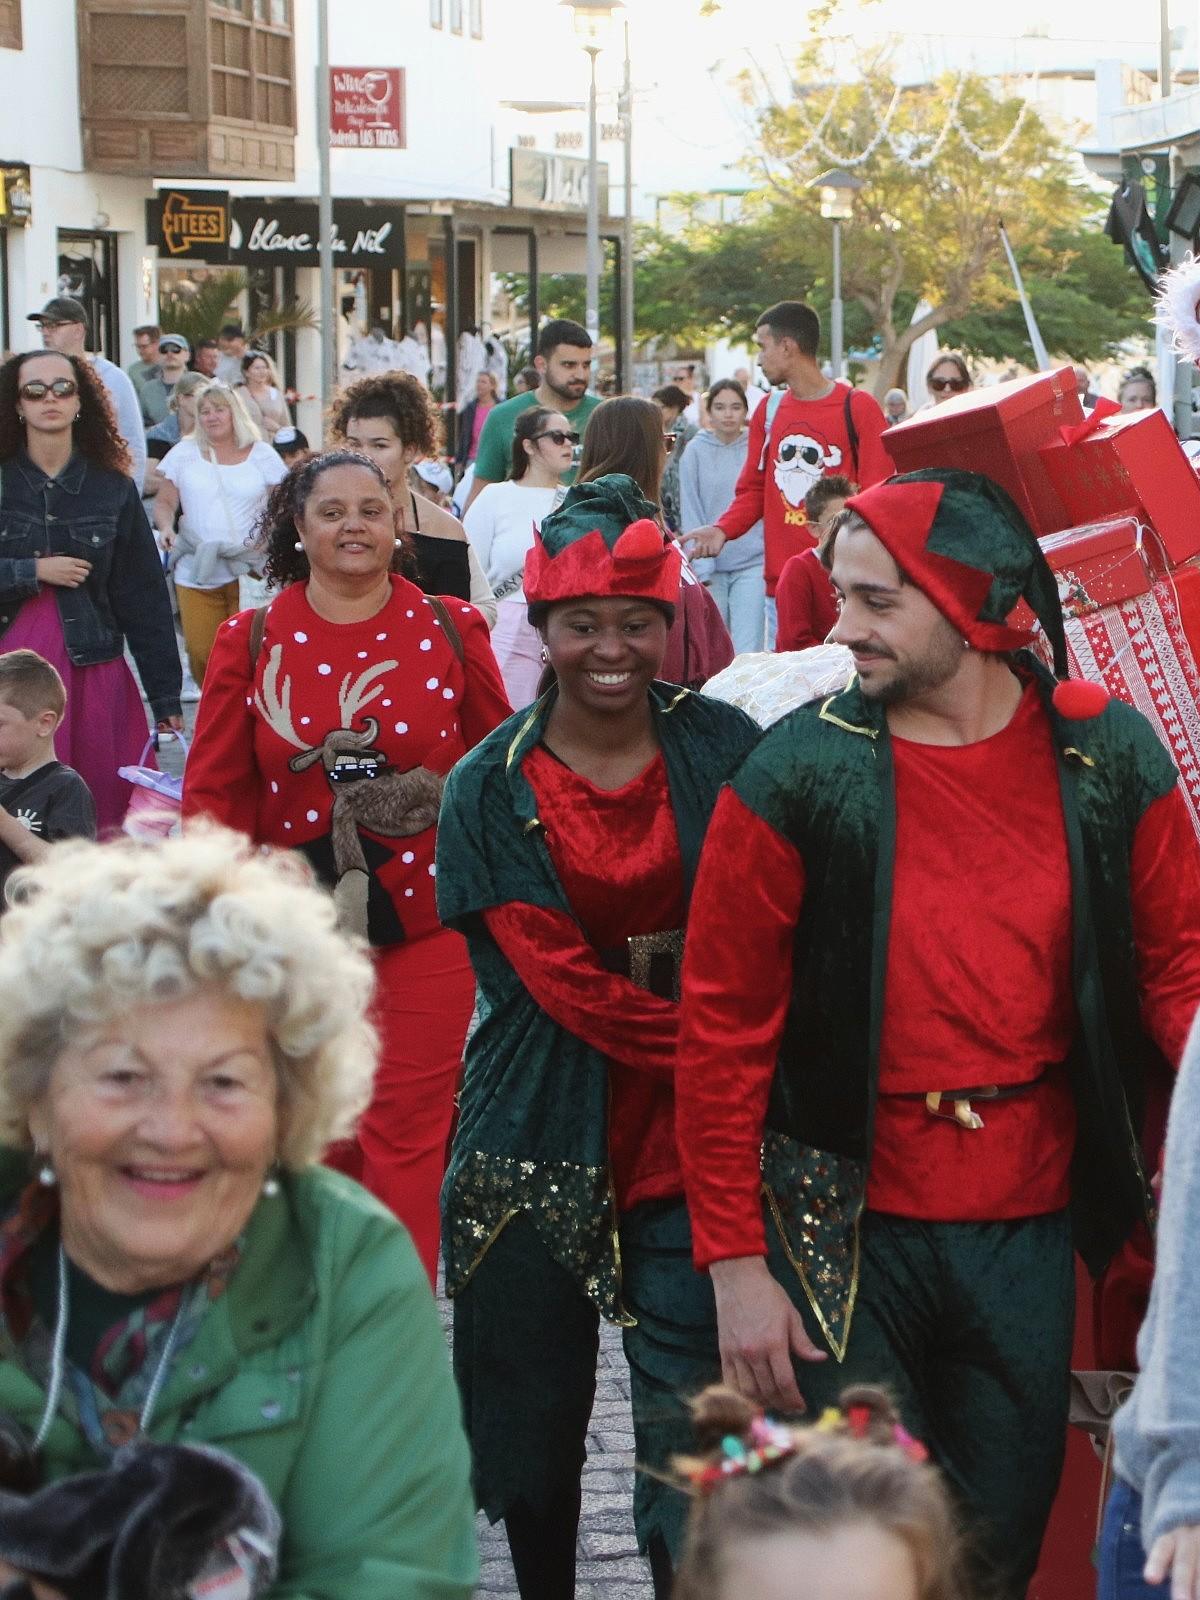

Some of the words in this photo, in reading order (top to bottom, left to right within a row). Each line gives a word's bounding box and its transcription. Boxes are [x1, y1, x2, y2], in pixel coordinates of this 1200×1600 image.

[163, 213, 218, 235] CITEES
[248, 217, 313, 251] blanc
[351, 221, 393, 254] Nil
